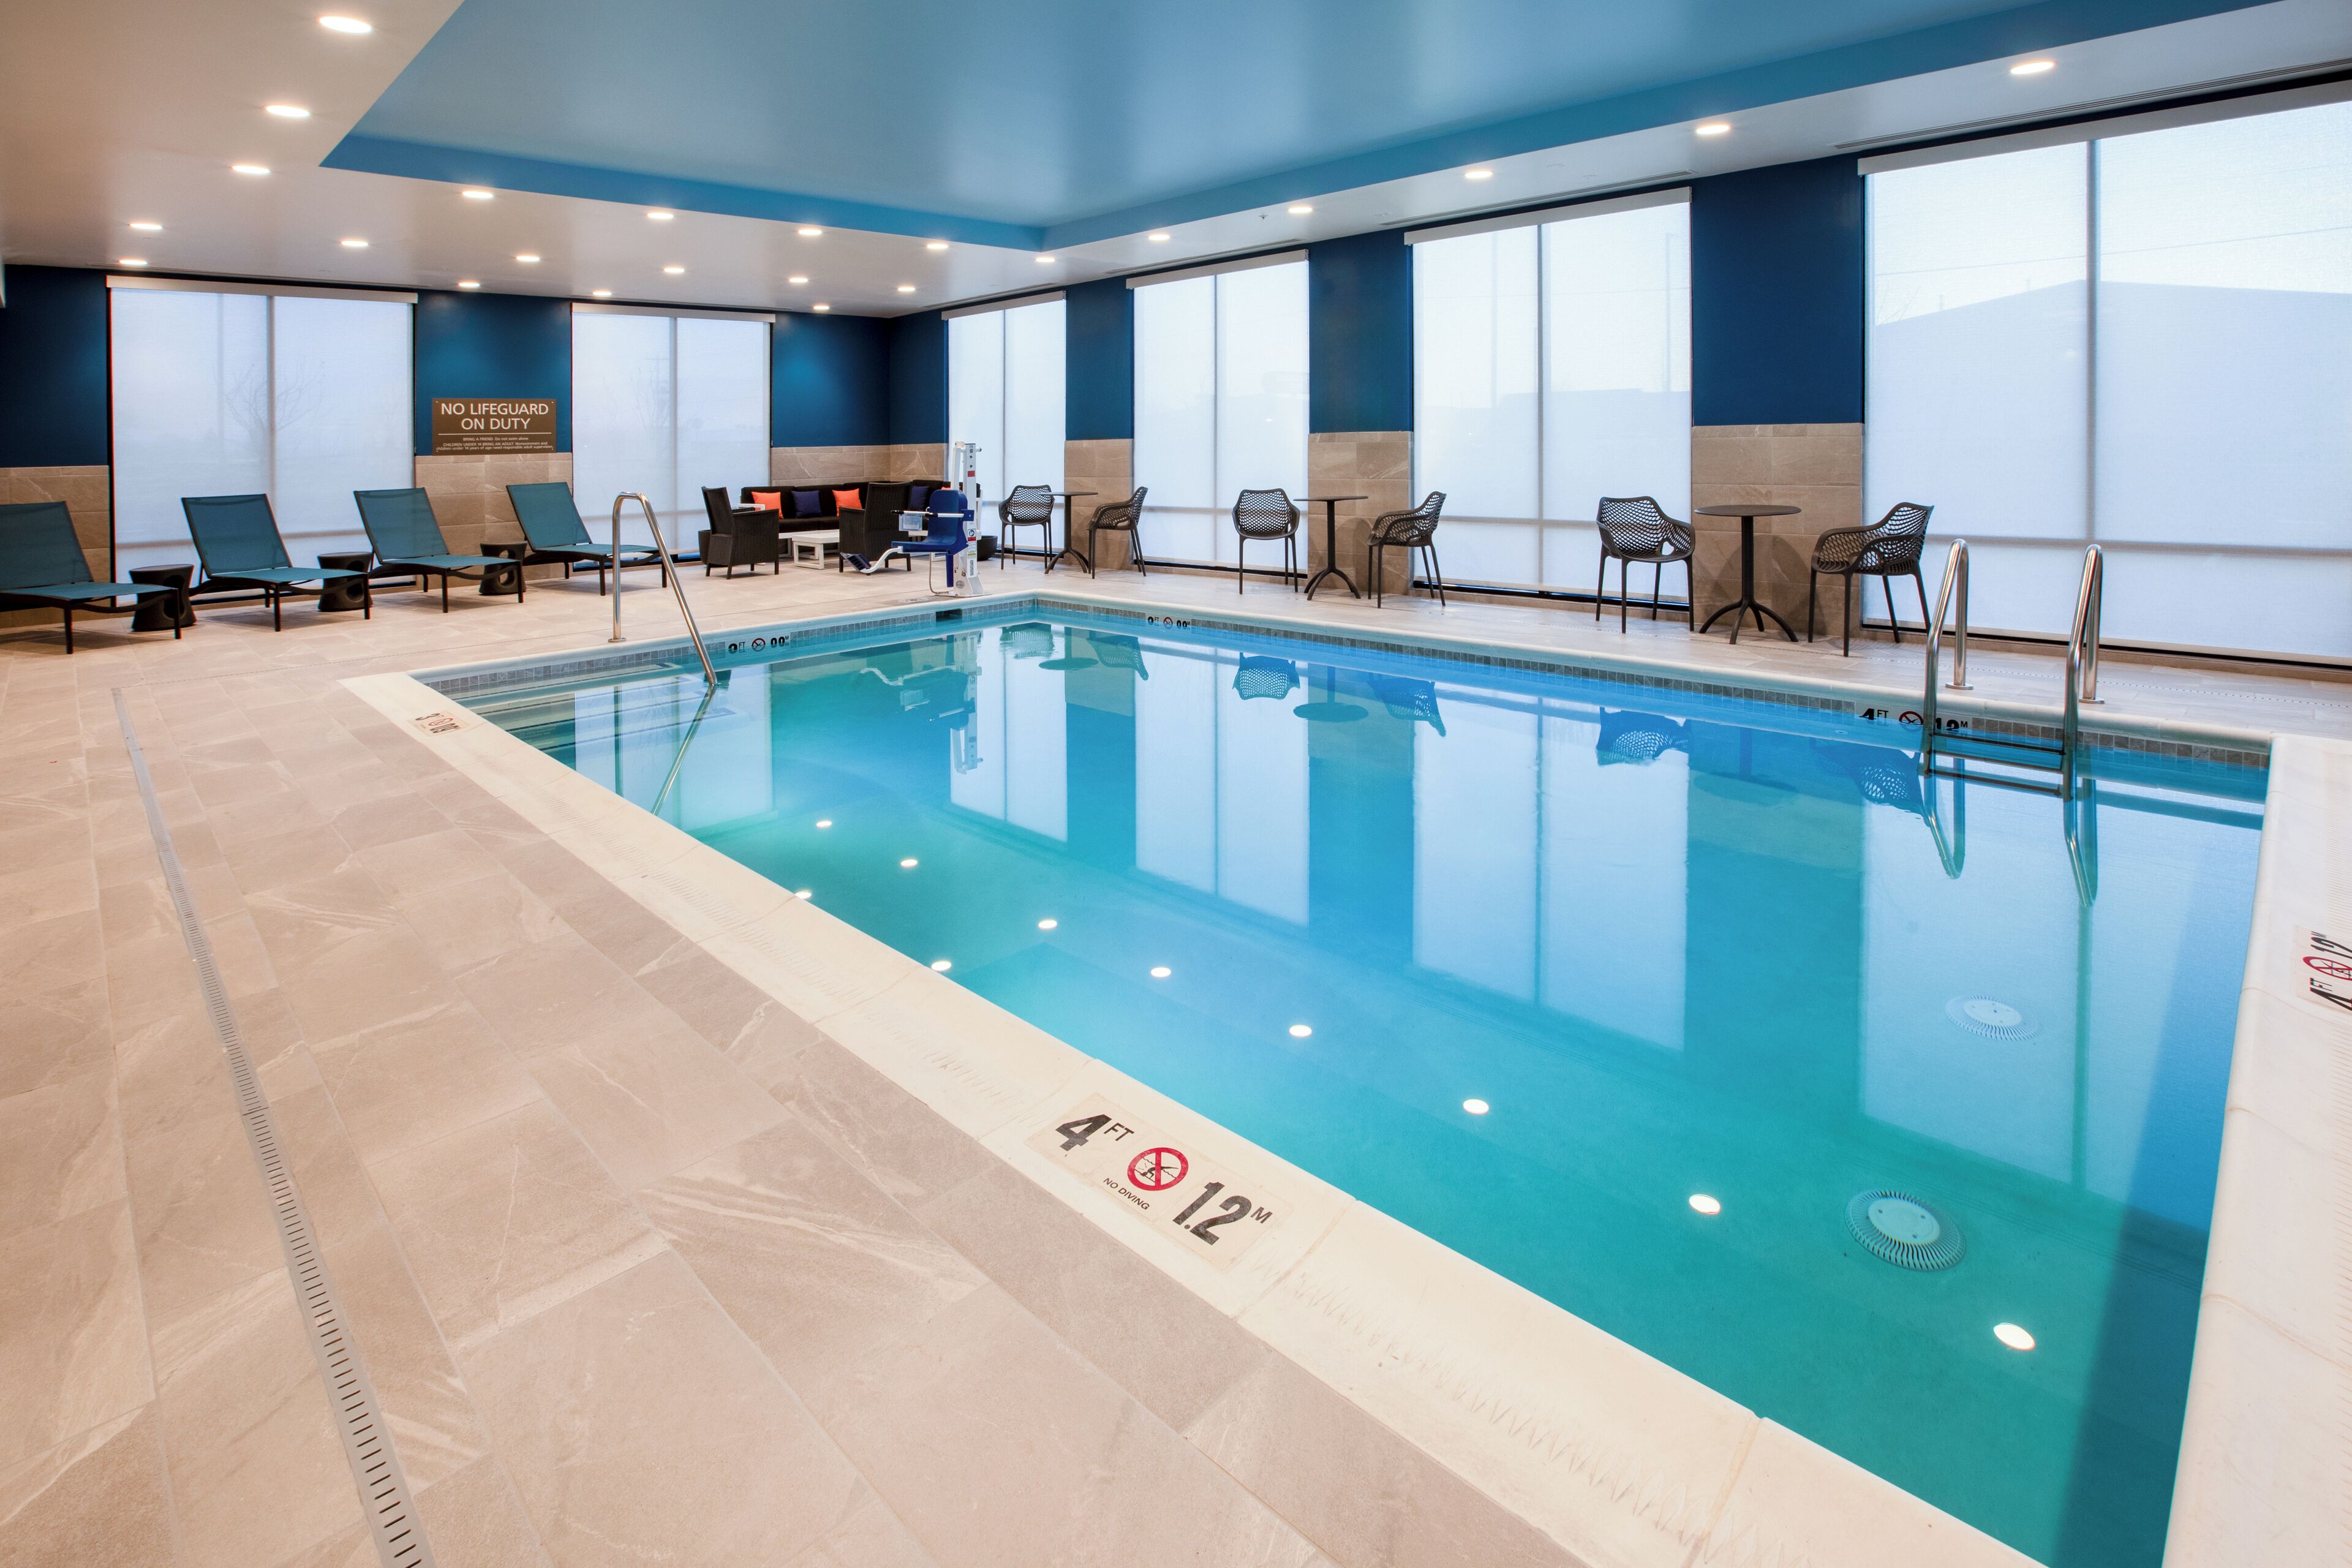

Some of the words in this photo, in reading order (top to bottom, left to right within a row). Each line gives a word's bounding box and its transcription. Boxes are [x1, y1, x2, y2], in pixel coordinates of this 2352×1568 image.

[441, 403, 465, 415] NO
[470, 403, 549, 415] LIFEGUARD
[461, 418, 484, 430] ON
[490, 418, 530, 429] DUTY
[1859, 708, 1877, 720] 4
[1877, 709, 1889, 718] FT
[2310, 978, 2332, 992] FT
[1055, 1114, 1112, 1152] 4
[1103, 1122, 1134, 1142] FT
[1102, 1177, 1120, 1189] NO
[1118, 1187, 1150, 1211] DIVING
[1172, 1182, 1252, 1246] 1.2
[1250, 1206, 1273, 1224] M
